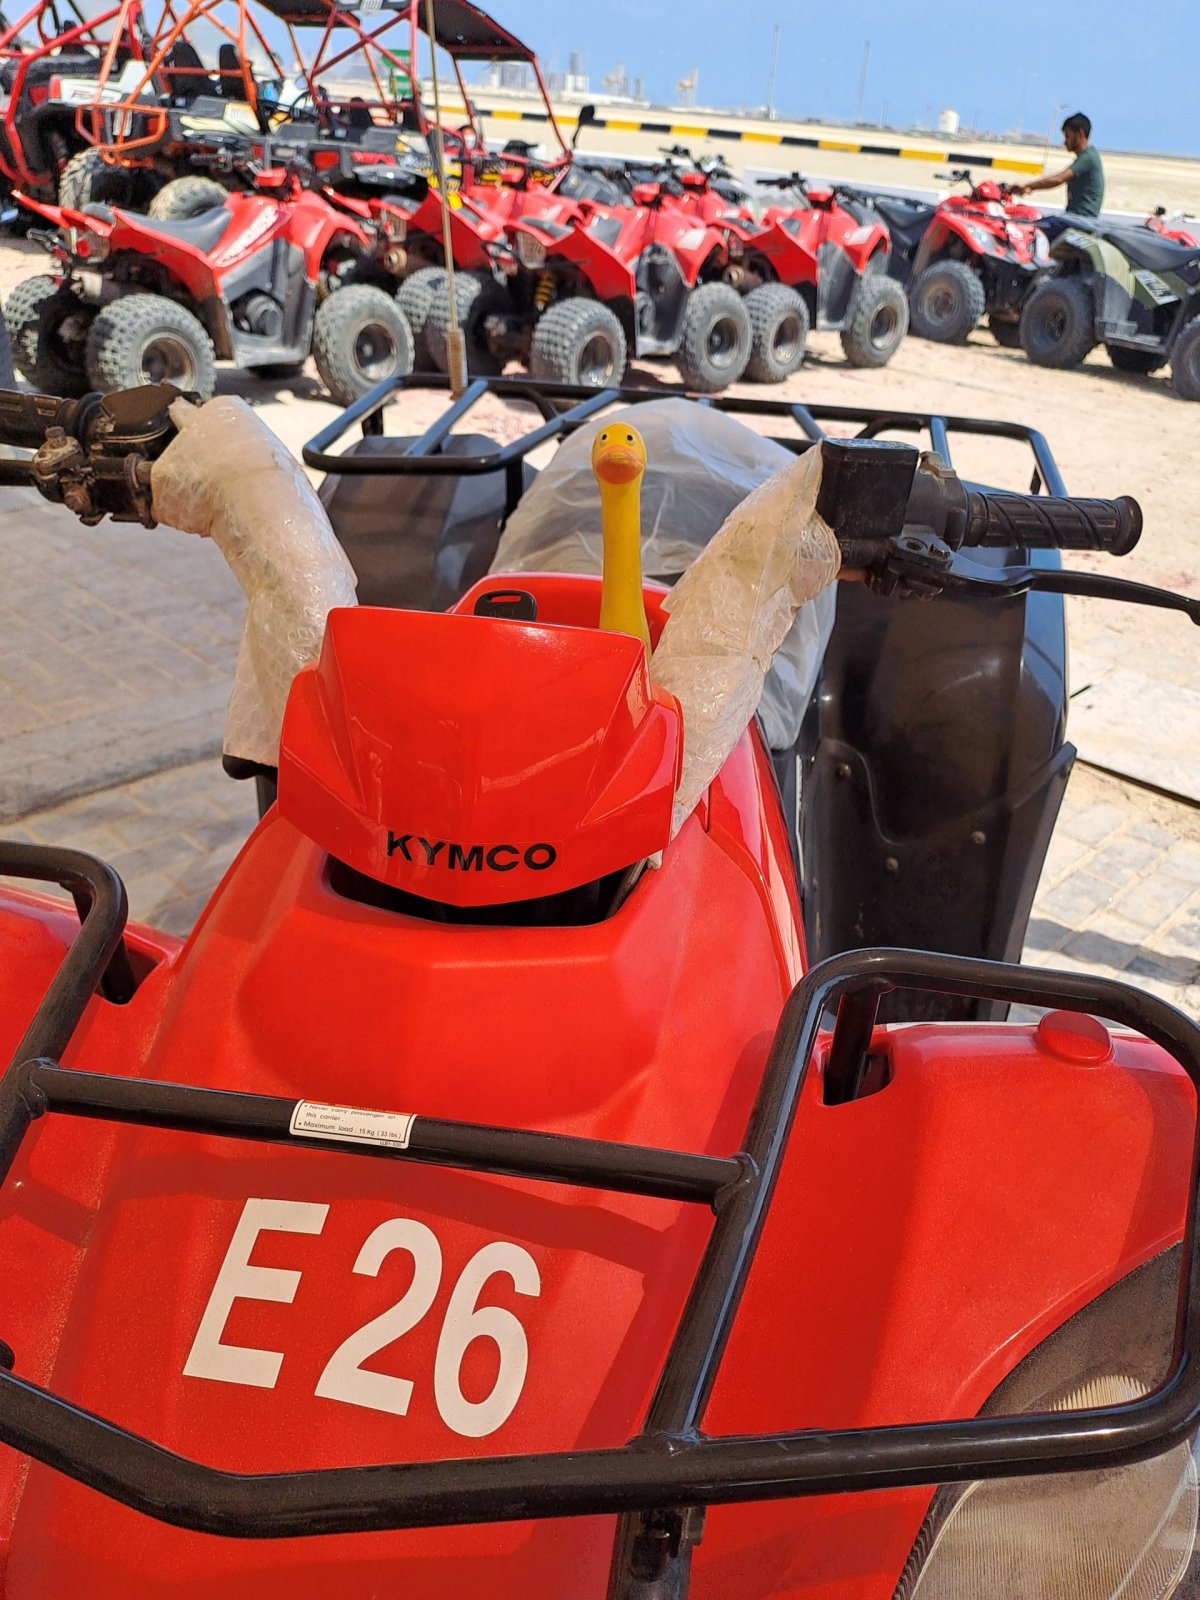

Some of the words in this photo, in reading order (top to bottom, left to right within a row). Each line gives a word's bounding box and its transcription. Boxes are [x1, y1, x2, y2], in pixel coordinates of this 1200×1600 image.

[387, 830, 557, 872] KYMCO
[304, 1120, 336, 1130] Maximum
[351, 1110, 385, 1119] passenger
[182, 1197, 331, 1389] E
[314, 1218, 542, 1438] 26
